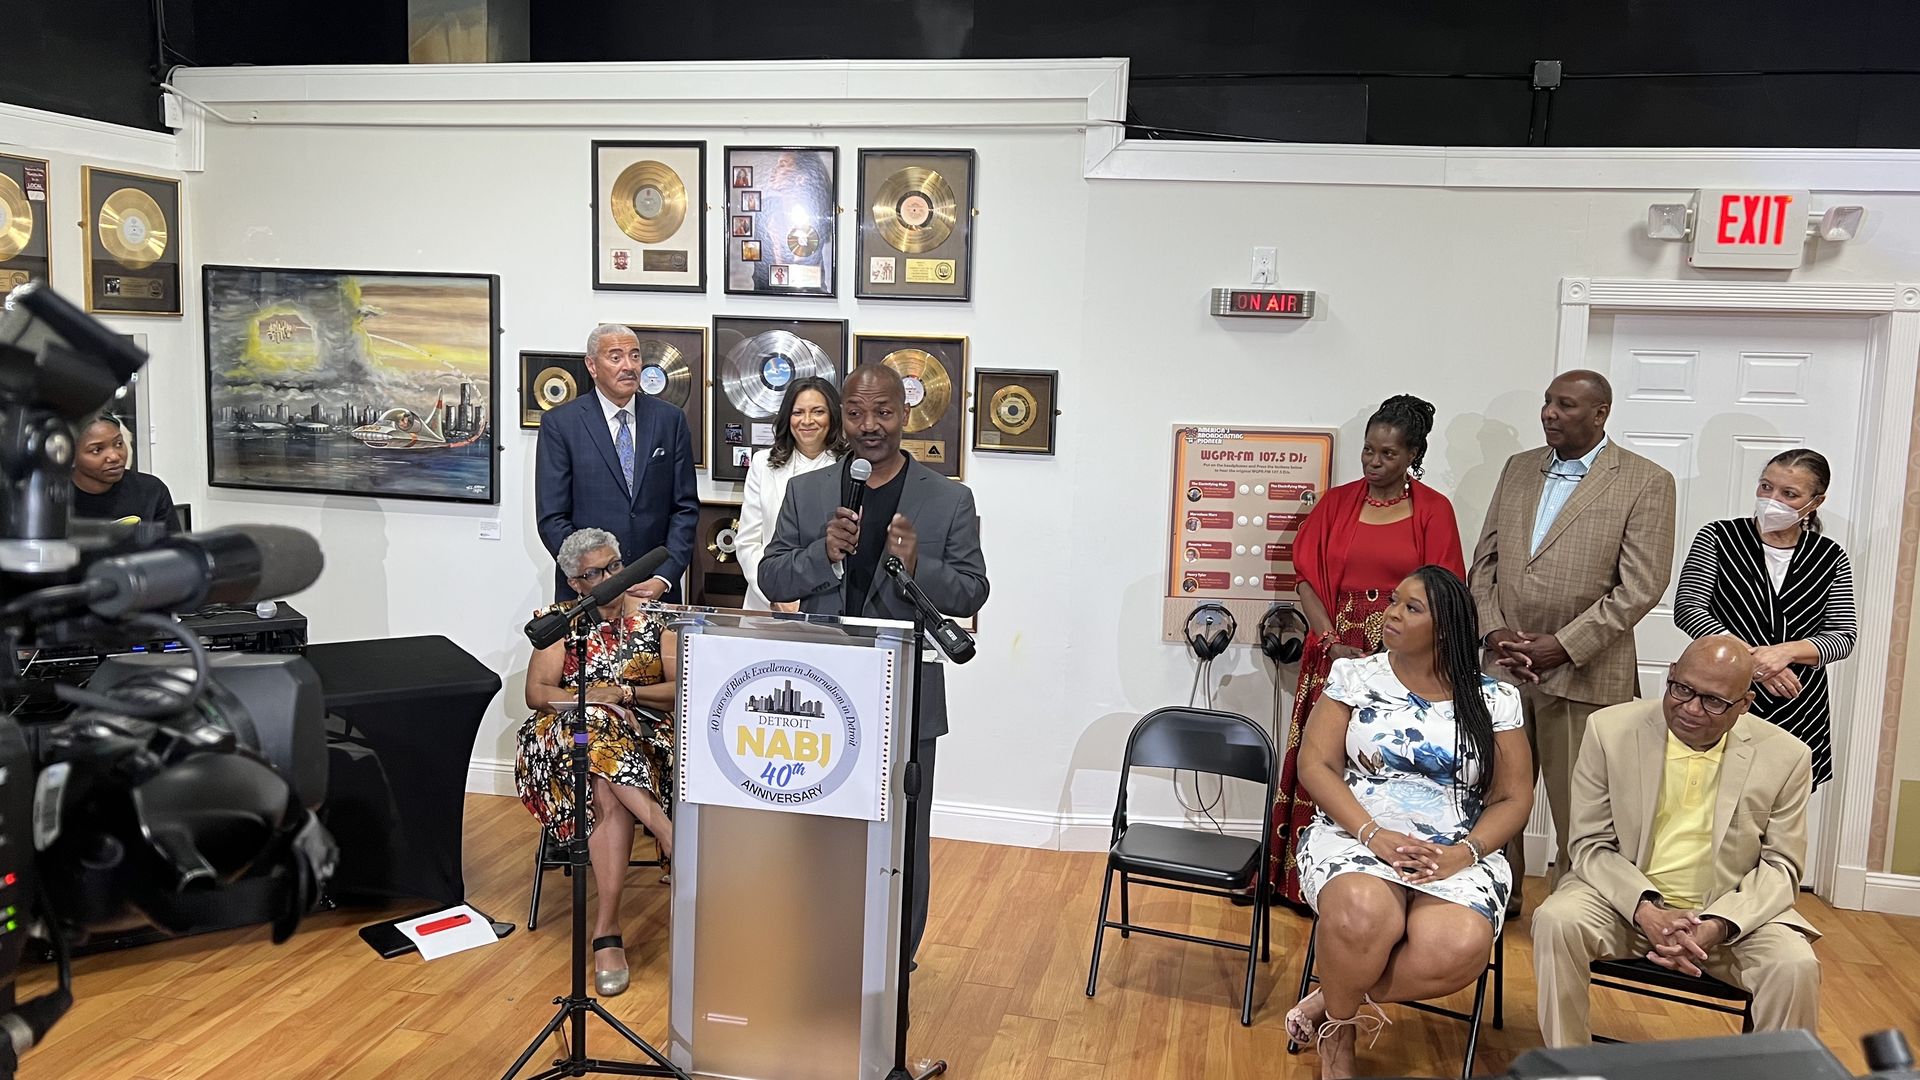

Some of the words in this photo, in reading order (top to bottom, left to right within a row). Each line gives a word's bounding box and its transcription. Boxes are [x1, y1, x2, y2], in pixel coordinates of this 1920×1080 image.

[1717, 195, 1792, 244] EXIT
[1238, 294, 1260, 310] ON
[1266, 294, 1297, 312] AIR
[1200, 450, 1254, 462] WGPR-FM
[1260, 452, 1286, 462] 107.5
[1289, 452, 1308, 463] DJs
[752, 662, 794, 676] Excellence
[794, 664, 804, 675] in
[730, 670, 752, 691] Black
[804, 668, 845, 704] Journalism
[724, 684, 733, 698] of
[712, 696, 728, 718] Years
[842, 704, 851, 714] in
[710, 720, 720, 732] 40
[758, 716, 812, 728] DETROIT
[846, 716, 858, 746] Detroit
[736, 725, 832, 768] NABJ
[760, 761, 806, 788] 40th
[741, 780, 823, 804] ANNIVERSARY
